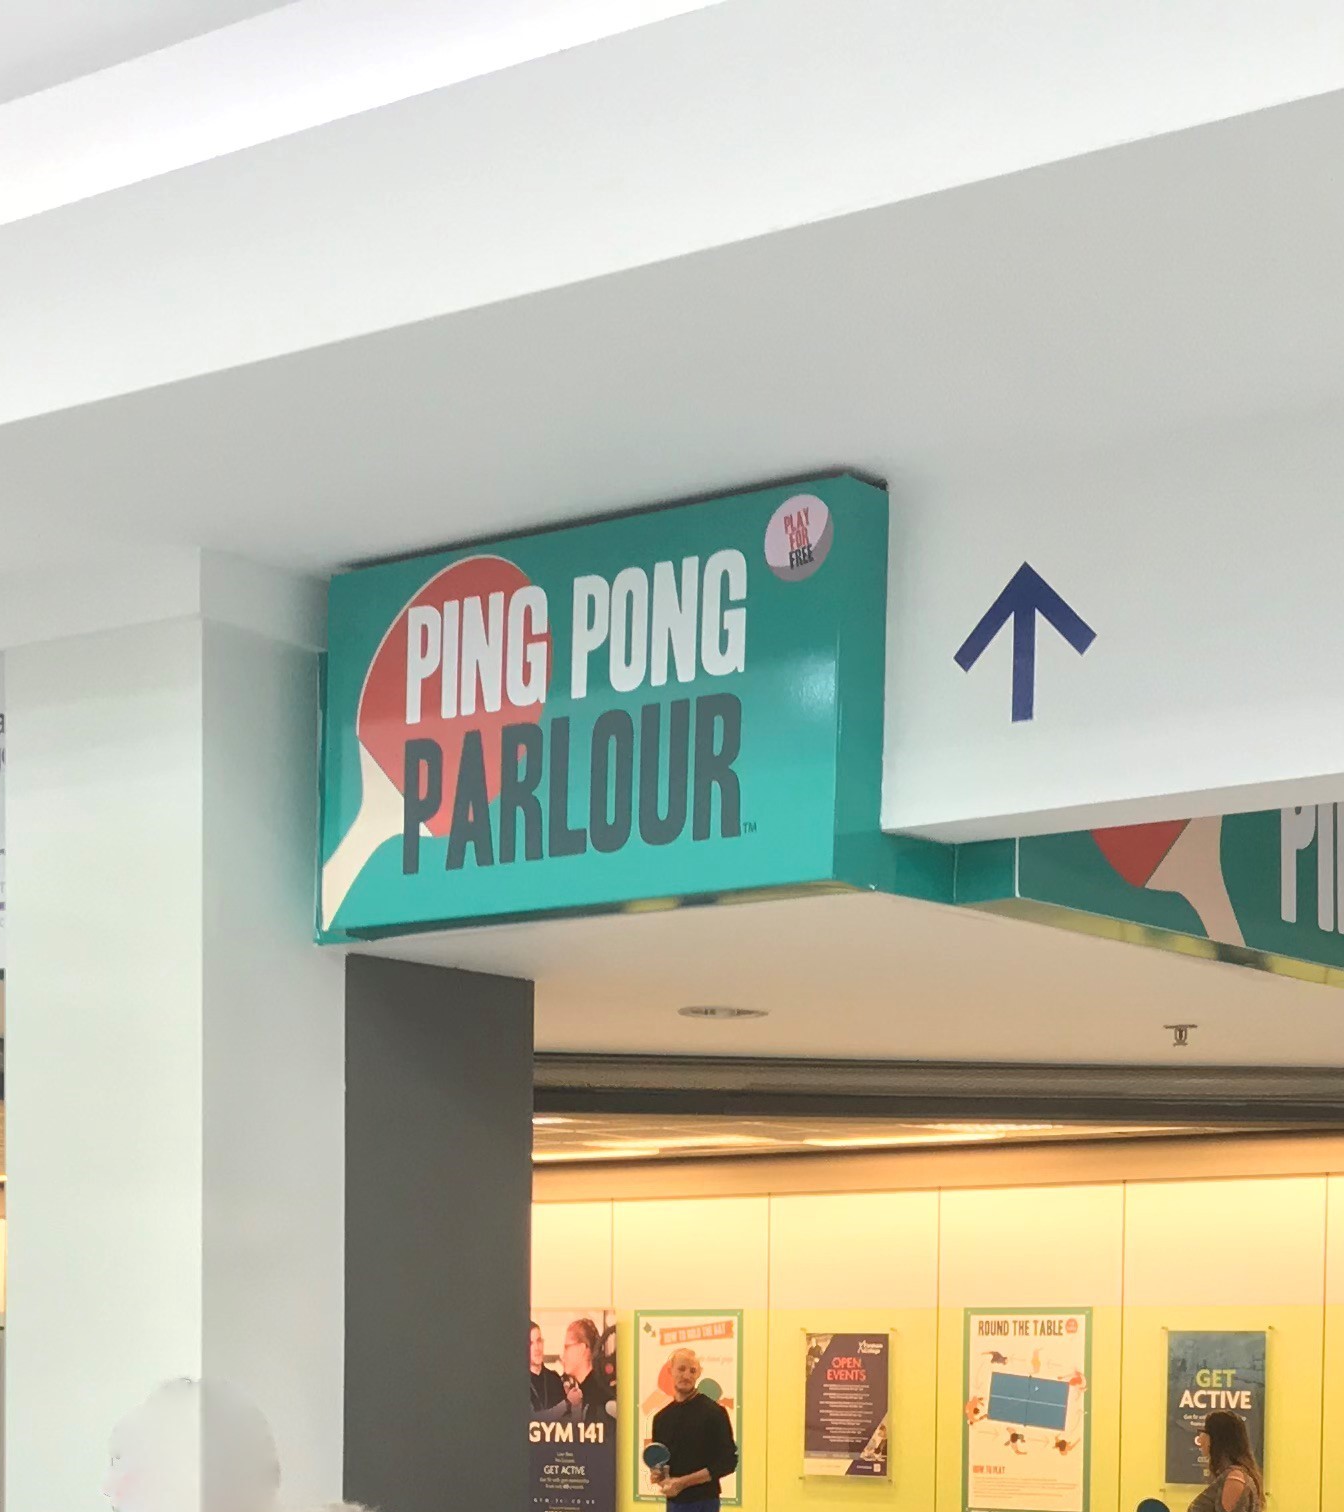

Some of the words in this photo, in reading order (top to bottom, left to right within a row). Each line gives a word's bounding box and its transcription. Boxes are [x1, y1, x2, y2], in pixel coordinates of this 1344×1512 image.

[783, 506, 809, 535] PLAY
[789, 527, 809, 551] FOR
[789, 543, 814, 570] FREE
[405, 585, 549, 725] PING
[570, 548, 747, 699] PONG
[402, 693, 743, 875] PARLOUR
[978, 1320, 1009, 1336] ROUND
[1012, 1320, 1029, 1336] THE
[1033, 1320, 1063, 1336] TABLE
[831, 1357, 862, 1369] OPEN
[826, 1369, 866, 1381] EVENTS
[1196, 1369, 1236, 1388] GET
[1179, 1389, 1252, 1409] ACTIVE
[529, 1421, 574, 1443] GYM
[577, 1422, 604, 1443] 141
[543, 1465, 558, 1475] GET
[561, 1465, 585, 1475] ACTIVE
